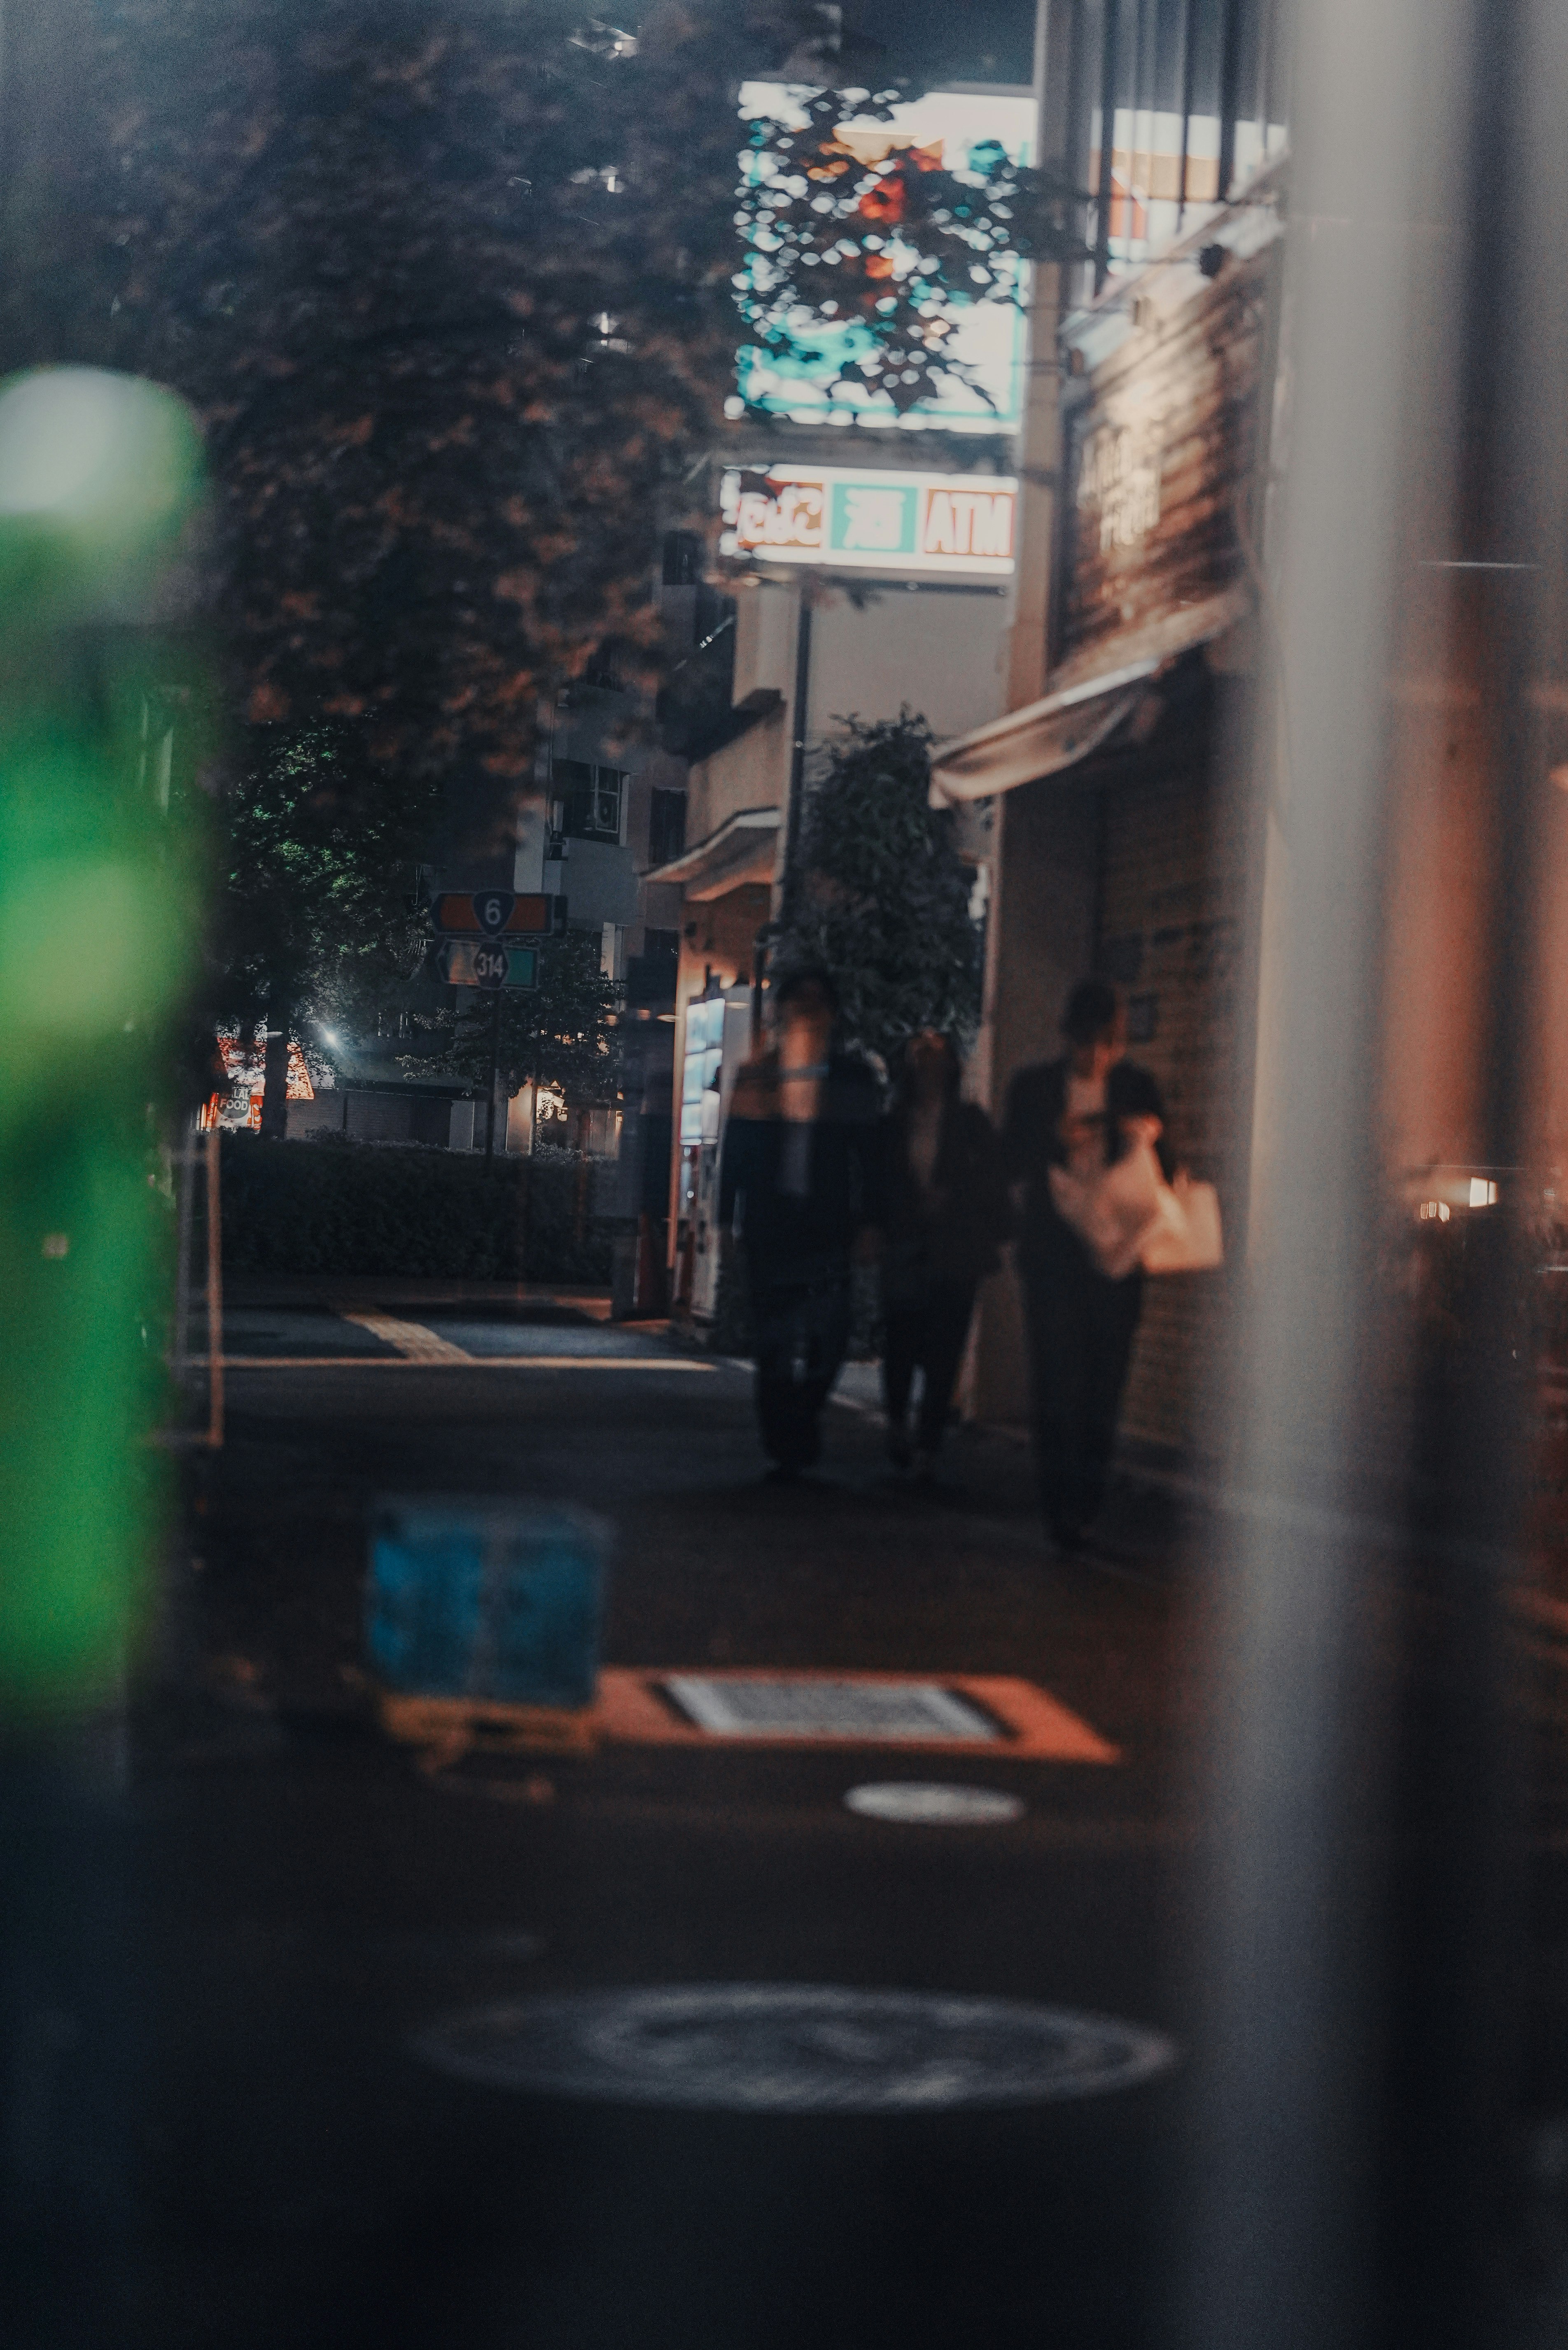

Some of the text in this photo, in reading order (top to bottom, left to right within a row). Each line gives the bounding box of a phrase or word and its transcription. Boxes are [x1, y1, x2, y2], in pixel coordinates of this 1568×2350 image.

[925, 491, 1013, 556] ATM
[486, 899, 500, 924] 6
[477, 952, 504, 978] 314
[220, 1098, 248, 1111] FOOD
